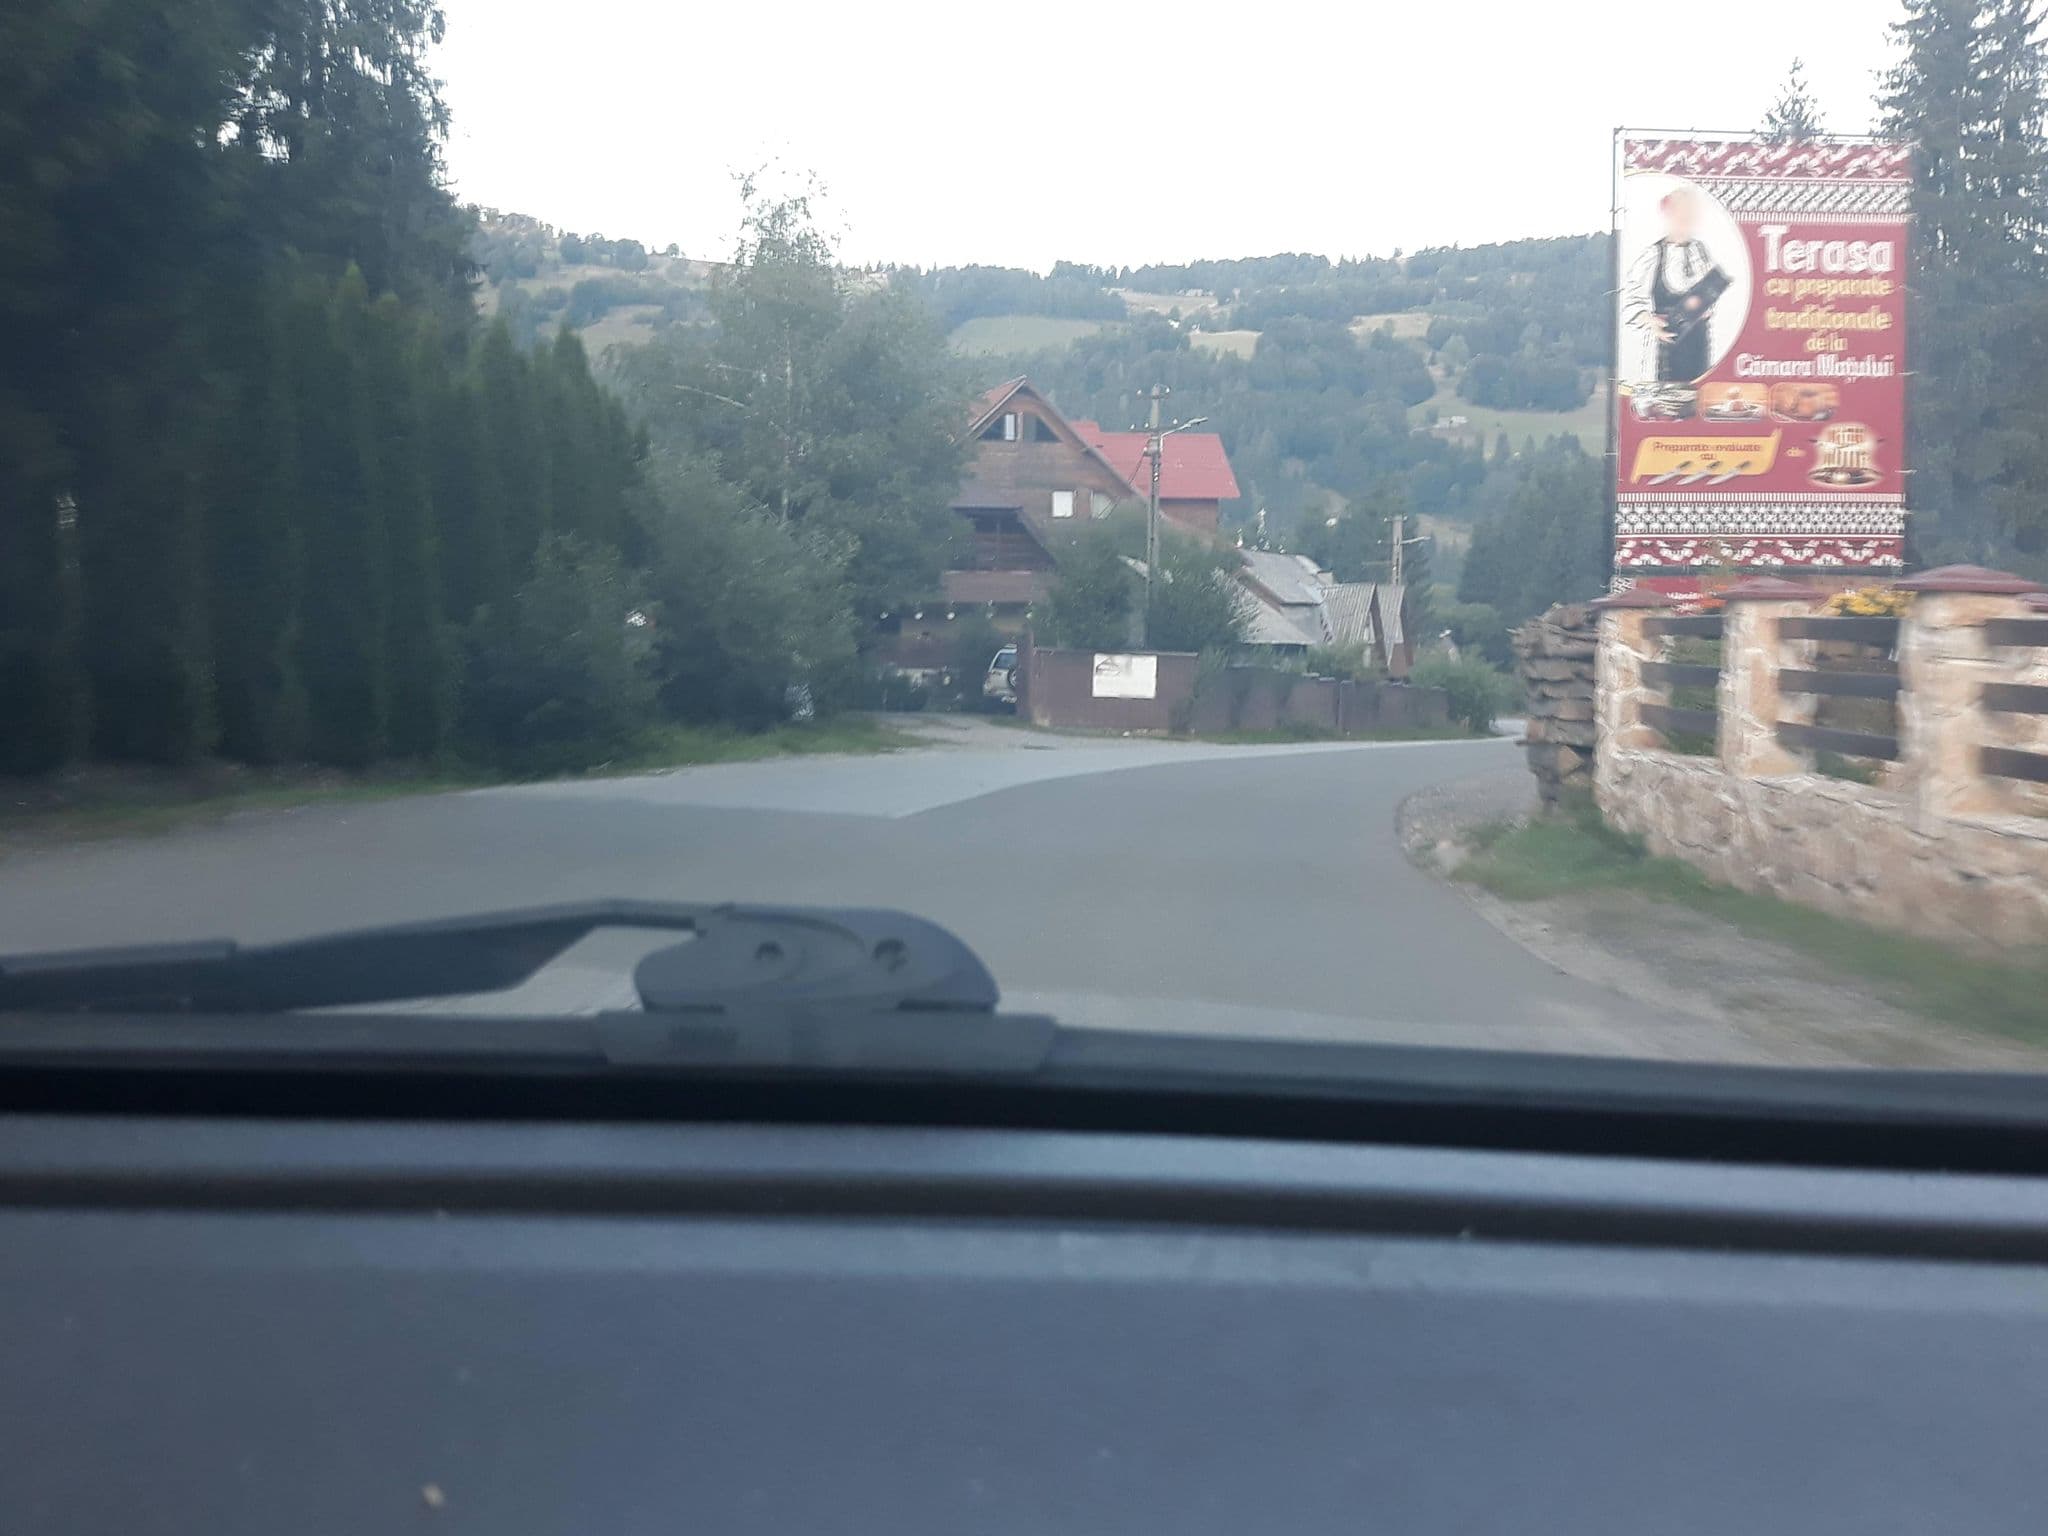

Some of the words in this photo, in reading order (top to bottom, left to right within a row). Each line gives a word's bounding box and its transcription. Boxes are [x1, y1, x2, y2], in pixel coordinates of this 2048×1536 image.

[1758, 225, 1895, 273] Terasa
[1766, 278, 1790, 296] cu
[1793, 276, 1894, 303] preparate
